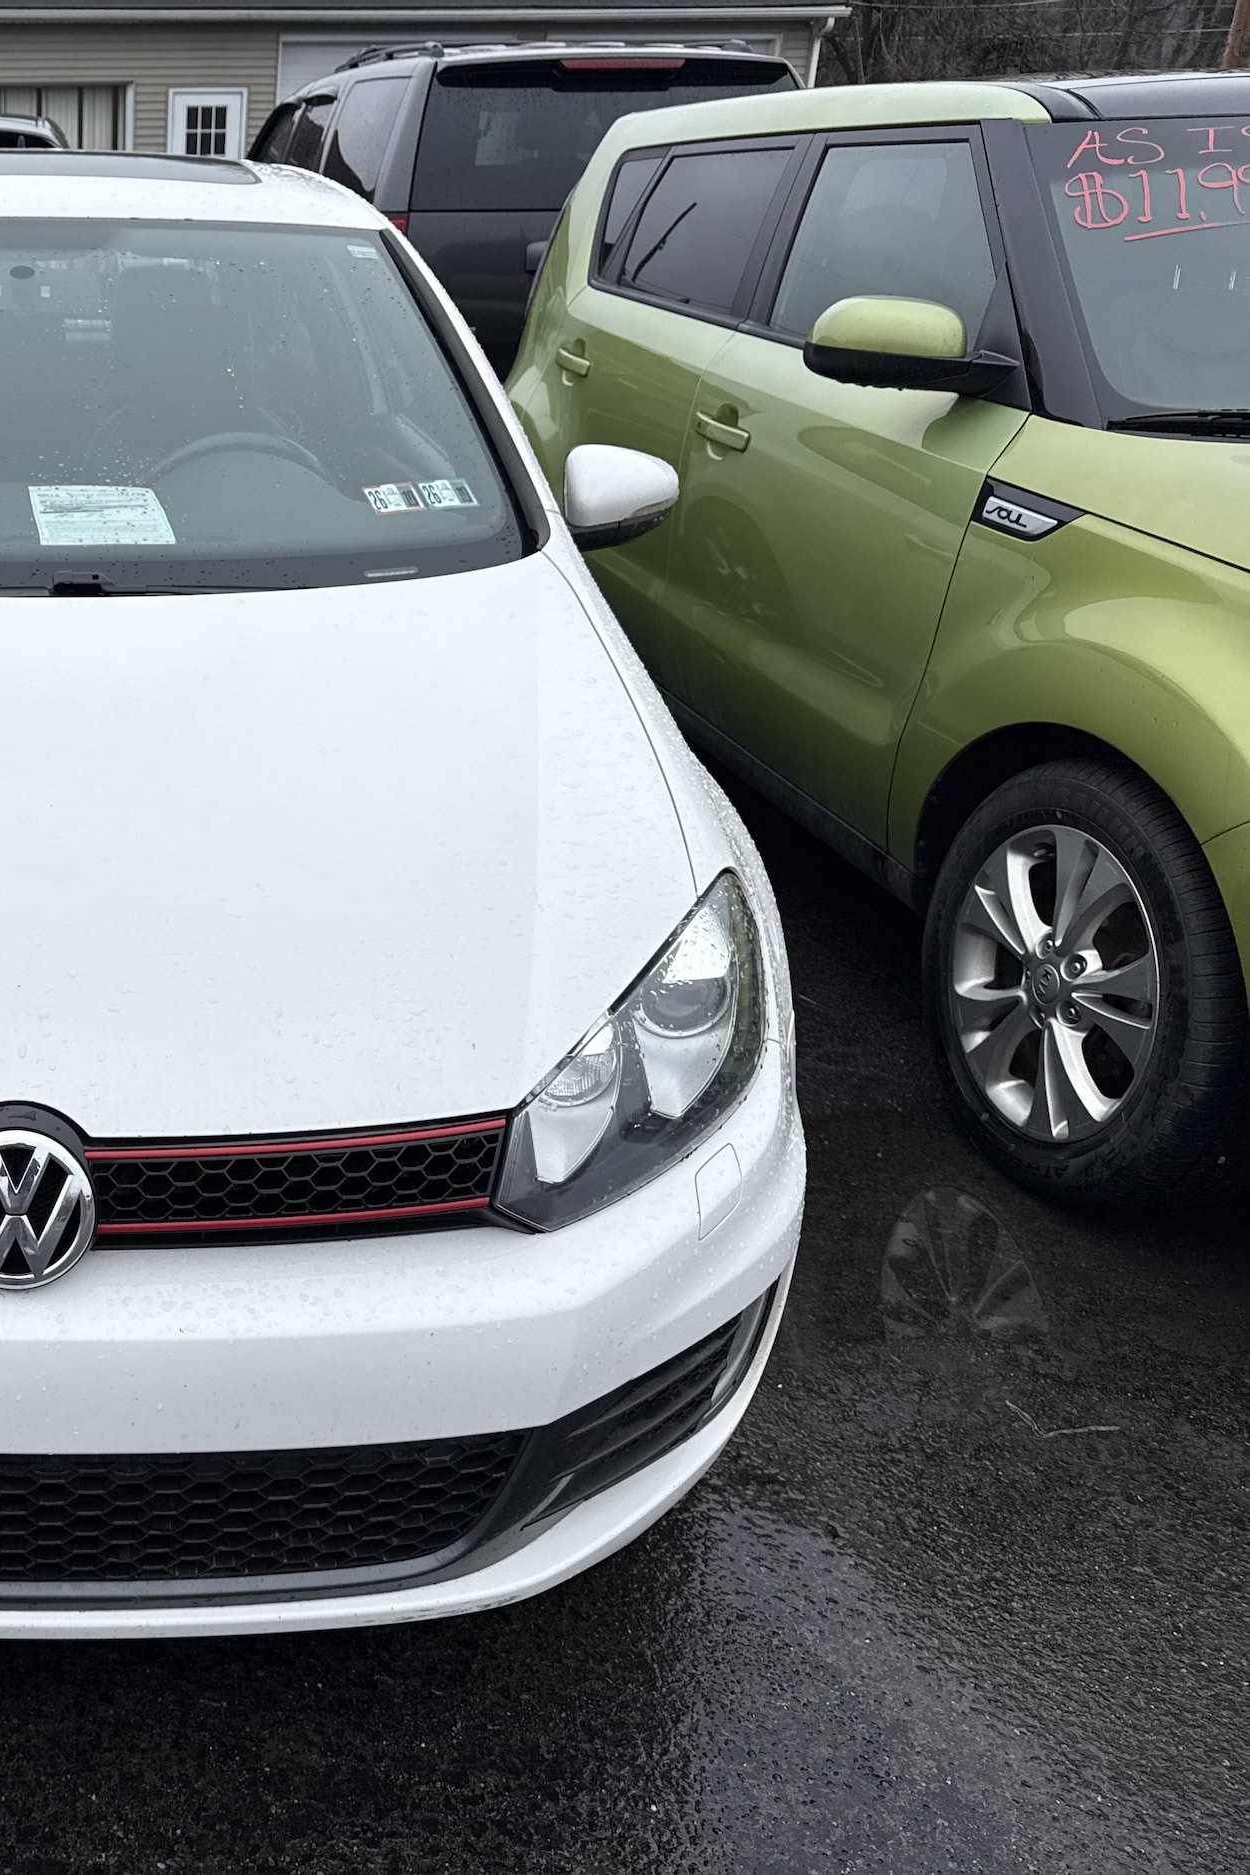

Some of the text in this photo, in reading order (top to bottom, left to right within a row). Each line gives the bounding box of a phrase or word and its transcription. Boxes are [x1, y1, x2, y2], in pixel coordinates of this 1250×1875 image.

[1067, 127, 1165, 168] AS
[368, 490, 388, 510] 26
[422, 485, 442, 504] 26
